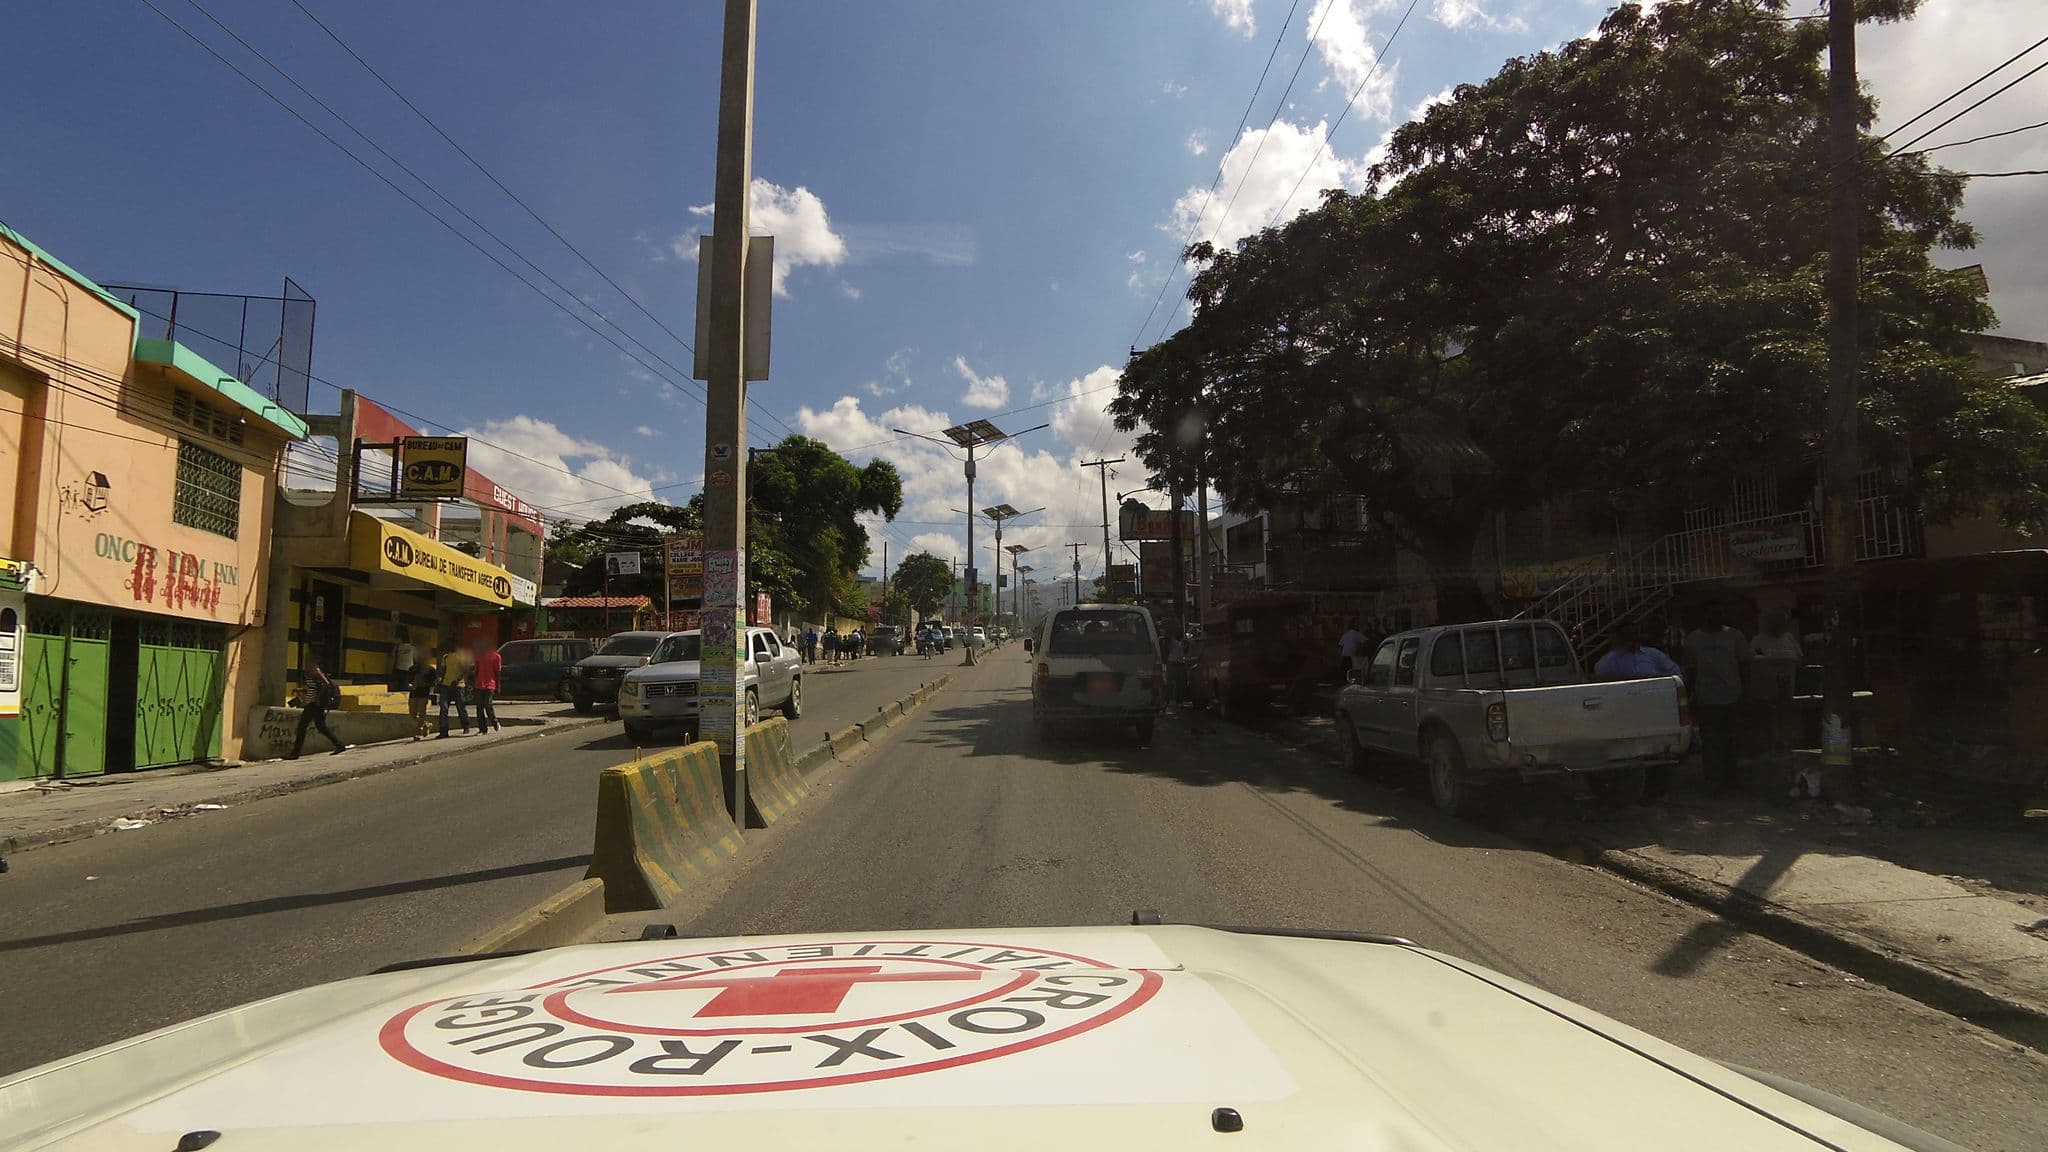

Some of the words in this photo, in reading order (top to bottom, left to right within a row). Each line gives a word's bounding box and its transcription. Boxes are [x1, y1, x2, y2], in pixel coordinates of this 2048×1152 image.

[407, 440, 438, 450] BUREAU
[407, 465, 455, 481] C.A.M.
[493, 485, 517, 511] GUEST
[386, 538, 411, 565] C.A.M.
[415, 548, 438, 570] BUREAU
[439, 557, 448, 574] DE
[448, 561, 478, 583] TRANSFERT
[433, 972, 1130, 1077] CROIX-ROUGE
